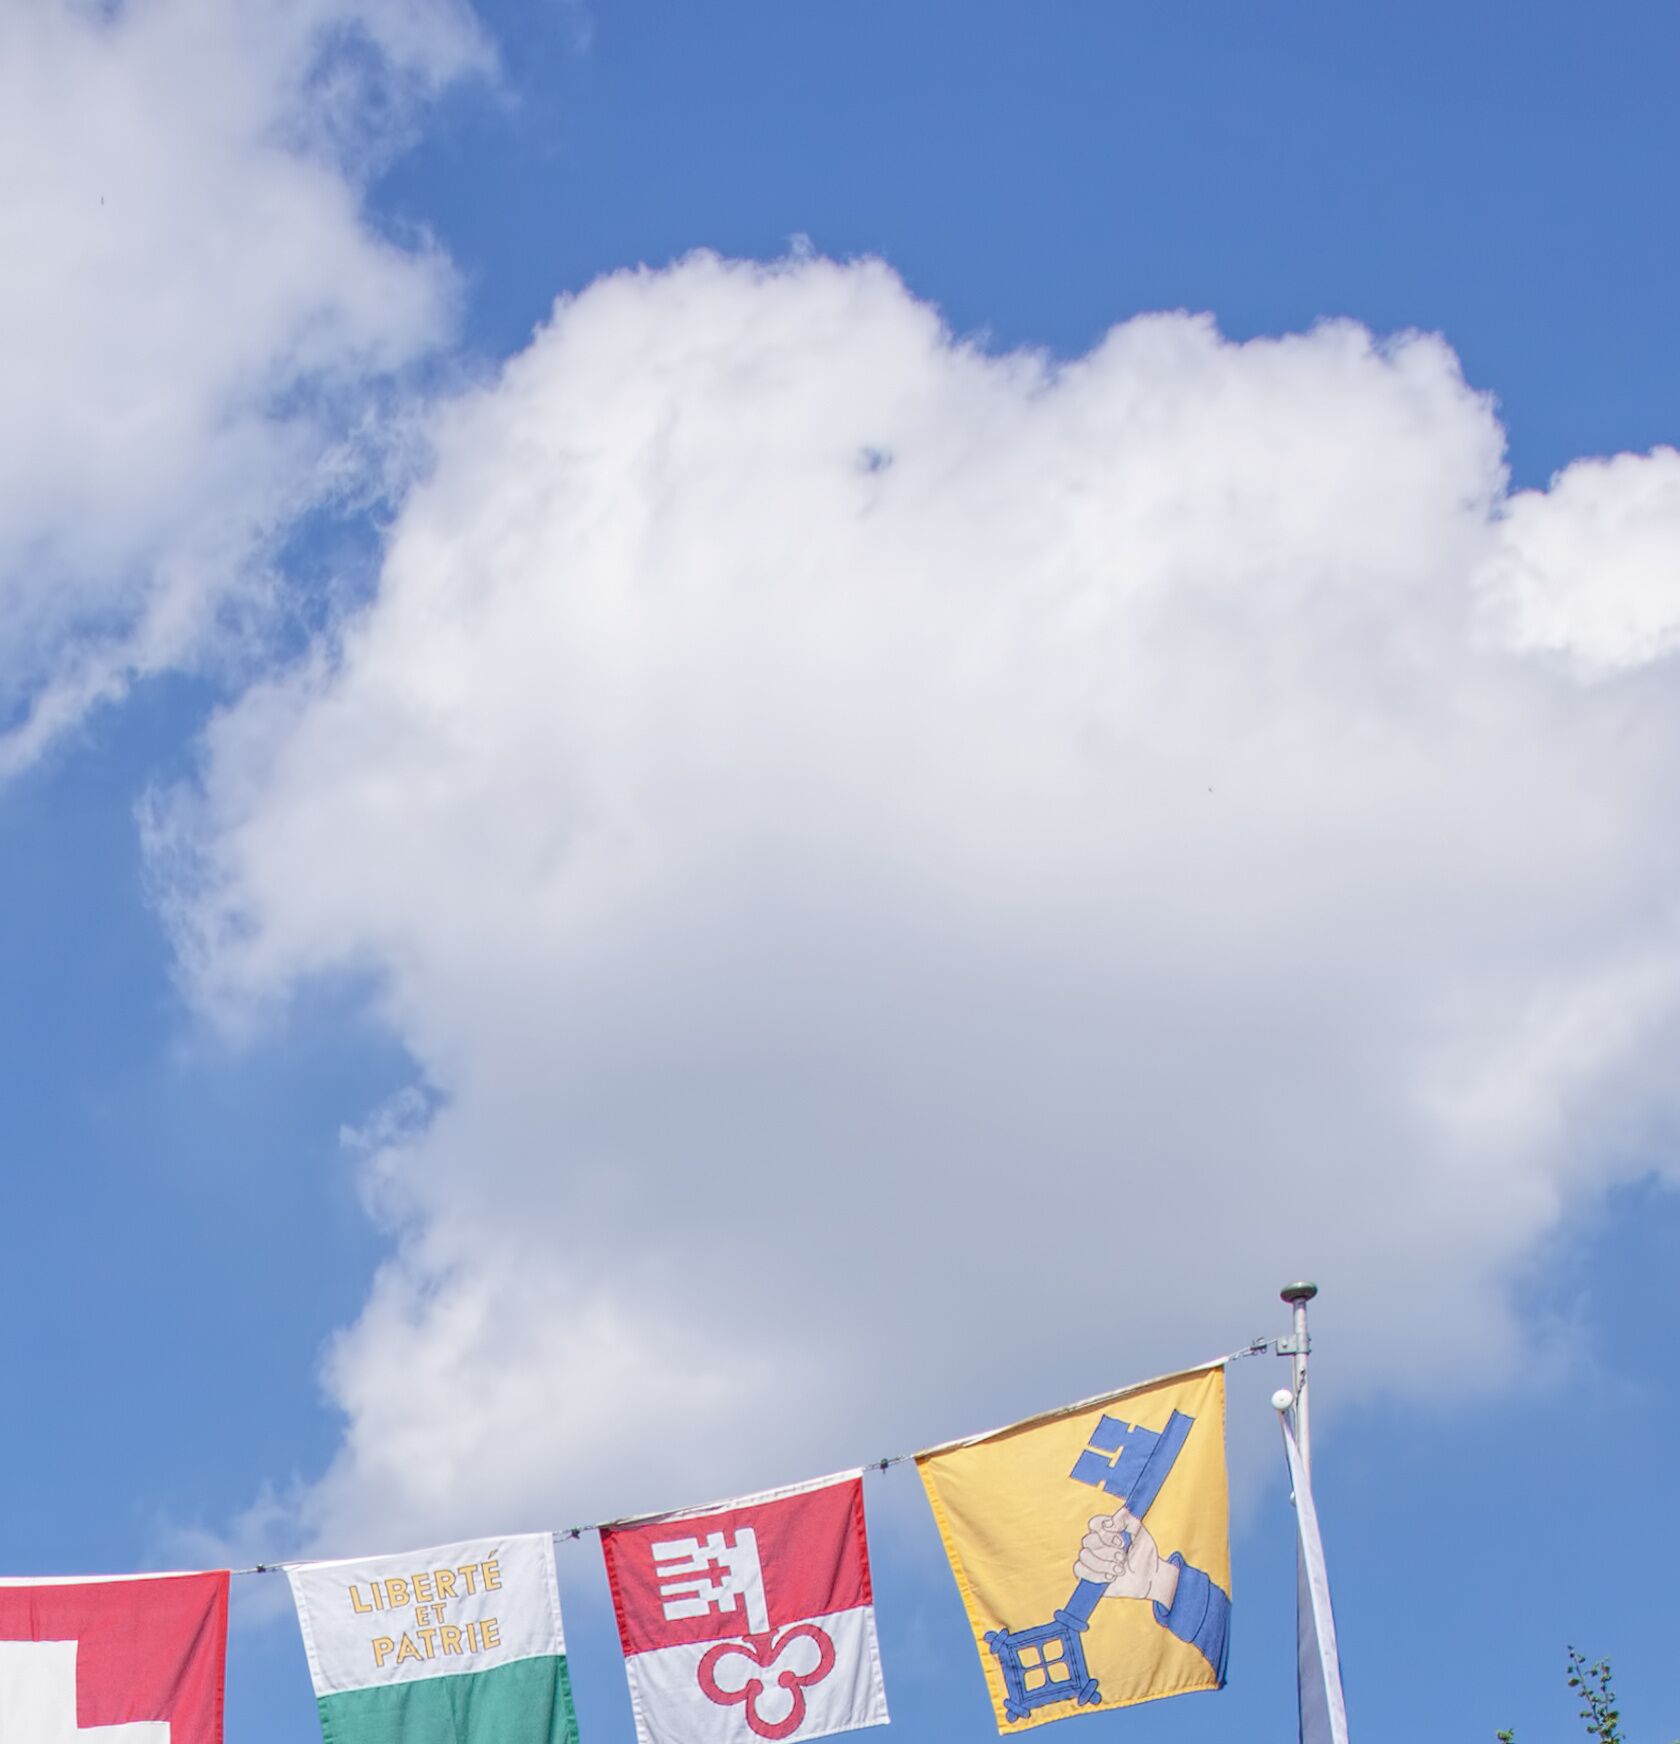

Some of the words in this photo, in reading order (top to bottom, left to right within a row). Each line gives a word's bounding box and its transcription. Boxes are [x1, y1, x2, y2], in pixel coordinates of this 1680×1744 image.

[349, 1549, 502, 1614] LIBERTÉ
[415, 1603, 447, 1627] ET
[372, 1618, 501, 1667] PATRIE
